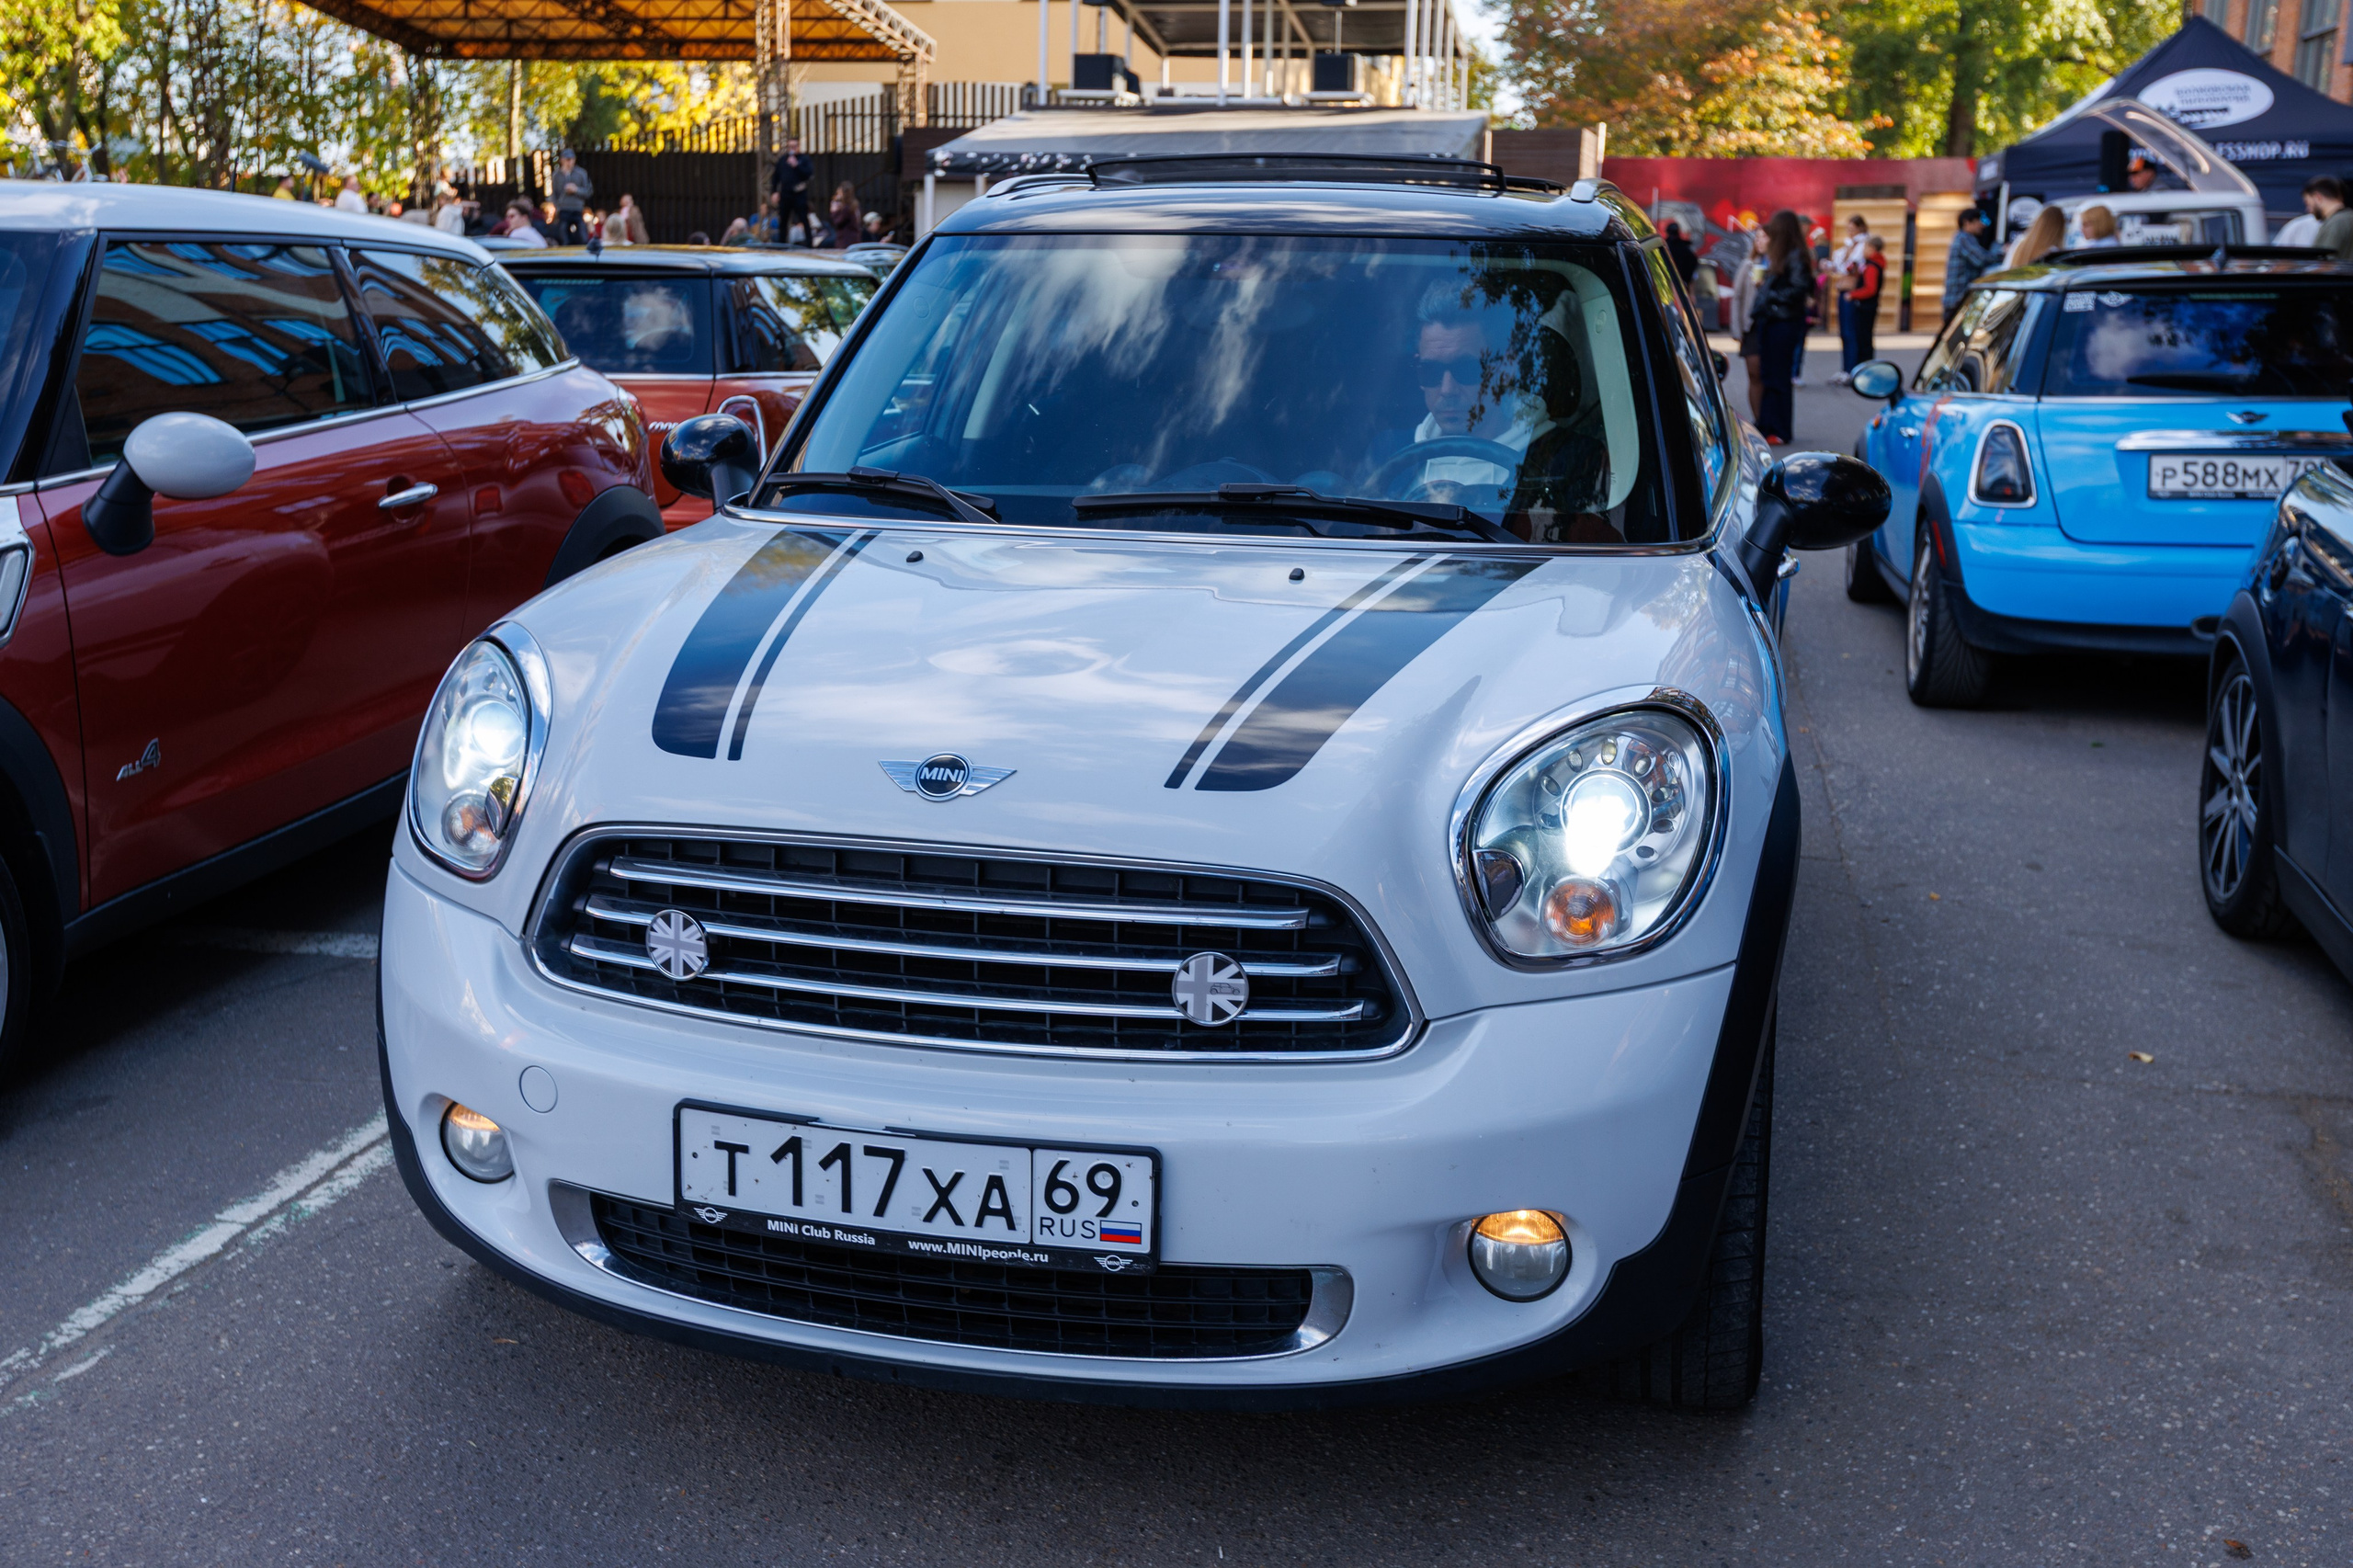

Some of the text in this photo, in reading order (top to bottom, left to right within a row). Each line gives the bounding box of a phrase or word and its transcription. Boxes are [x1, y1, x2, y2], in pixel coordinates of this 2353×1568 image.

[2161, 461, 2280, 488] Р588МХ
[920, 767, 965, 783] MINI
[713, 1136, 1121, 1231] Т117ХА 69
[767, 1219, 876, 1245] MINI Club Russia
[1040, 1217, 1097, 1239] RUS
[907, 1240, 1050, 1263] www.MINIpeople.ru
